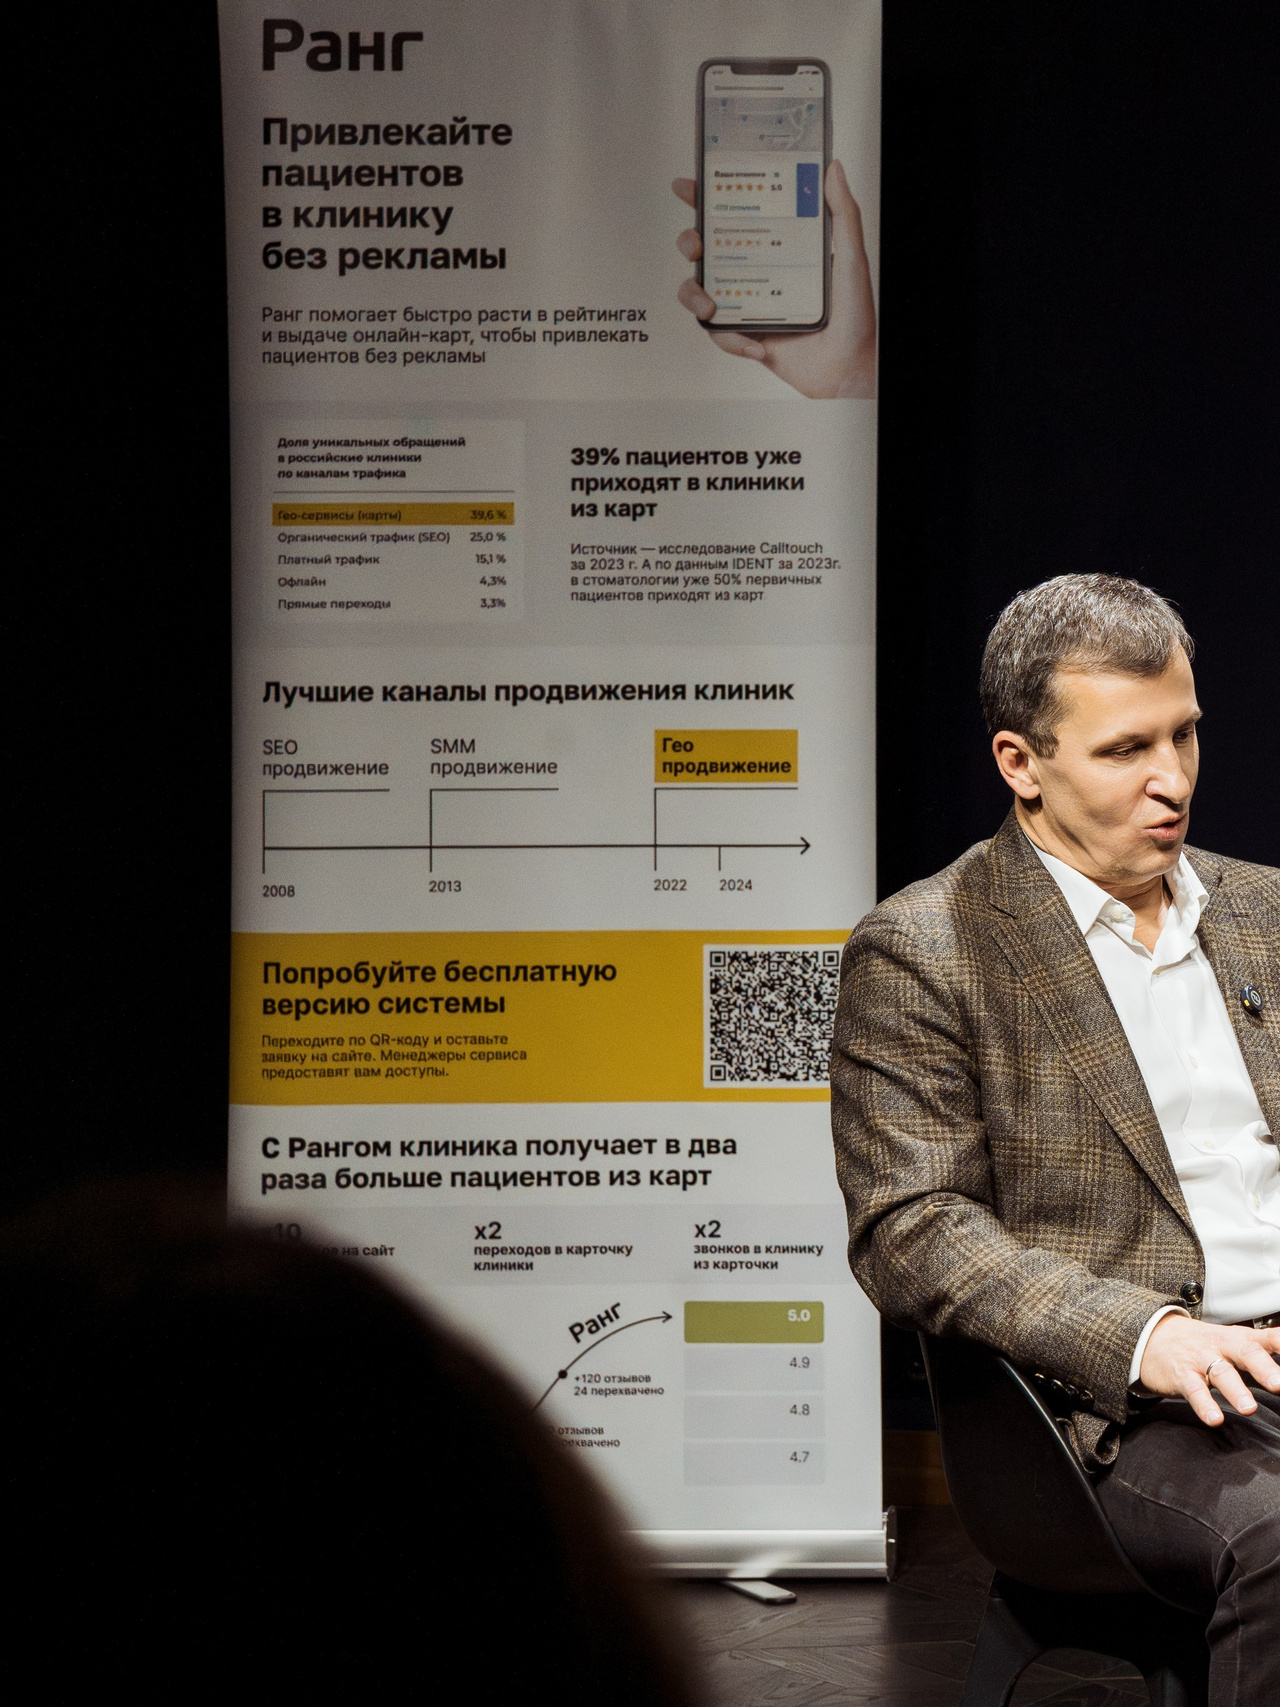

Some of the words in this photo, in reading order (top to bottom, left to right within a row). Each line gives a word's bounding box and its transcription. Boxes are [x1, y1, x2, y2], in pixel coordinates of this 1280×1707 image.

[262, 18, 424, 73] Ранг
[262, 115, 513, 153] Привлекайте
[262, 164, 464, 192] пациентов
[262, 206, 283, 229] в
[293, 205, 454, 237] клинику
[262, 240, 328, 270] без
[338, 247, 507, 277] рекламы
[261, 306, 304, 323] Ранг
[308, 309, 398, 323] помогает
[402, 305, 473, 326] быстро
[477, 308, 532, 329] расти
[536, 308, 548, 323] в
[553, 306, 647, 326] рейтингах
[261, 330, 273, 343] и
[277, 329, 348, 346] выдаче
[352, 327, 475, 347] онлайн-карт,
[480, 326, 537, 344] чтобы
[541, 329, 650, 347] привлекать
[261, 350, 360, 367] пациентов
[364, 347, 398, 364] без
[402, 350, 486, 368] рекламы
[276, 437, 310, 449] Доля
[311, 438, 390, 450] уникальных
[392, 436, 467, 450] обращений
[278, 455, 285, 463] в
[287, 452, 364, 465] российские
[570, 447, 621, 466] 39%
[625, 450, 749, 469] пациентов
[754, 450, 802, 470] уже
[296, 470, 349, 478] каналам
[352, 468, 407, 481] трафика
[570, 476, 682, 497] приходят
[686, 476, 701, 492] в
[706, 476, 805, 492] клиники
[277, 509, 355, 522] Гео-сервисы
[356, 508, 403, 523] (карты)
[469, 509, 495, 522] 39,6
[495, 509, 508, 521] %
[570, 502, 599, 518] из
[604, 502, 658, 522] карт
[277, 531, 368, 545] Органический
[369, 531, 416, 545] трафик
[417, 531, 451, 545] (SEO)
[469, 531, 495, 543] 25,0
[495, 531, 507, 542] %
[570, 543, 638, 556] Источник
[658, 544, 757, 557] исследование
[759, 541, 824, 555] Calltouch
[277, 554, 332, 566] Платный
[334, 554, 380, 567] трафик
[475, 553, 494, 566] 15,1
[495, 553, 507, 564] %
[570, 560, 587, 571] за
[589, 557, 625, 571] 2023
[629, 561, 637, 569] г.
[641, 558, 652, 571] А
[654, 559, 673, 571] по
[674, 558, 730, 572] данным
[732, 557, 774, 571] IDENT
[778, 559, 794, 570] за
[796, 556, 843, 572] 2023г.
[277, 576, 327, 589] Офлайн
[479, 575, 507, 587] 4,3%
[570, 575, 579, 587] в
[581, 575, 680, 587] стоматологии
[682, 575, 711, 589] уже
[713, 572, 742, 586] 50%
[745, 575, 822, 588] первичных
[277, 598, 328, 611] Прямые
[329, 600, 392, 611] переходы
[480, 597, 507, 610] 3,3%
[570, 591, 644, 604] пациентов
[647, 590, 711, 604] приходят
[714, 590, 731, 602] из
[733, 590, 765, 603] карт
[262, 681, 375, 709] Лучшие
[381, 684, 487, 703] каналы
[494, 683, 687, 707] продвижения
[694, 683, 795, 701] клиник
[262, 738, 299, 756] SEO
[430, 737, 476, 755] SMM
[660, 737, 695, 755] Гео
[262, 762, 390, 780] продвижение
[430, 761, 558, 779] продвижение
[660, 760, 792, 778] продвижение
[261, 884, 296, 899] 2008
[428, 879, 463, 894] 2013
[653, 878, 688, 892] 2022
[719, 878, 753, 892] 2024
[263, 960, 437, 989] Попробуйте
[443, 959, 618, 988] бесплатную
[262, 996, 371, 1022] версию
[377, 995, 506, 1015] системы
[261, 1034, 346, 1050] Переходите
[348, 1035, 367, 1047] по
[369, 1032, 430, 1049] QR-коду
[433, 1035, 443, 1046] и
[445, 1034, 509, 1046] оставьте
[260, 1050, 307, 1065] заявку
[310, 1051, 328, 1063] на
[331, 1048, 377, 1063] сайте.
[379, 1048, 467, 1064] Менеджеры
[469, 1049, 528, 1063] сервиса
[260, 1065, 351, 1080] предоставят
[353, 1067, 382, 1079] вам
[384, 1066, 450, 1080] доступы.
[261, 1136, 280, 1160] С
[288, 1136, 392, 1159] Рангом
[399, 1139, 518, 1157] клиника
[525, 1138, 658, 1162] получает
[665, 1138, 681, 1155] в
[687, 1138, 738, 1159] два
[261, 1172, 327, 1196] раза
[334, 1167, 443, 1190] больше
[450, 1170, 601, 1191] пациентов
[608, 1169, 642, 1187] из
[649, 1168, 713, 1192] карт
[341, 1246, 358, 1256] на
[362, 1244, 395, 1256] сайт
[473, 1245, 552, 1258] переходов
[554, 1245, 564, 1256] в
[565, 1245, 634, 1258] карточку
[693, 1244, 751, 1255] звонков
[753, 1244, 762, 1255] в
[764, 1244, 824, 1257] клинику
[473, 1261, 534, 1272] клиники
[694, 1261, 709, 1269] из
[712, 1260, 779, 1273] карточки
[567, 1301, 622, 1345] Ранг
[787, 1309, 811, 1322] 5.0
[788, 1355, 811, 1369] 4.9
[604, 1375, 651, 1383] отзывов
[573, 1385, 588, 1397] 24
[590, 1387, 665, 1398] перехвачено
[789, 1403, 811, 1417] 4.8
[557, 1426, 604, 1436] отзывов
[789, 1450, 811, 1463] 4.7
